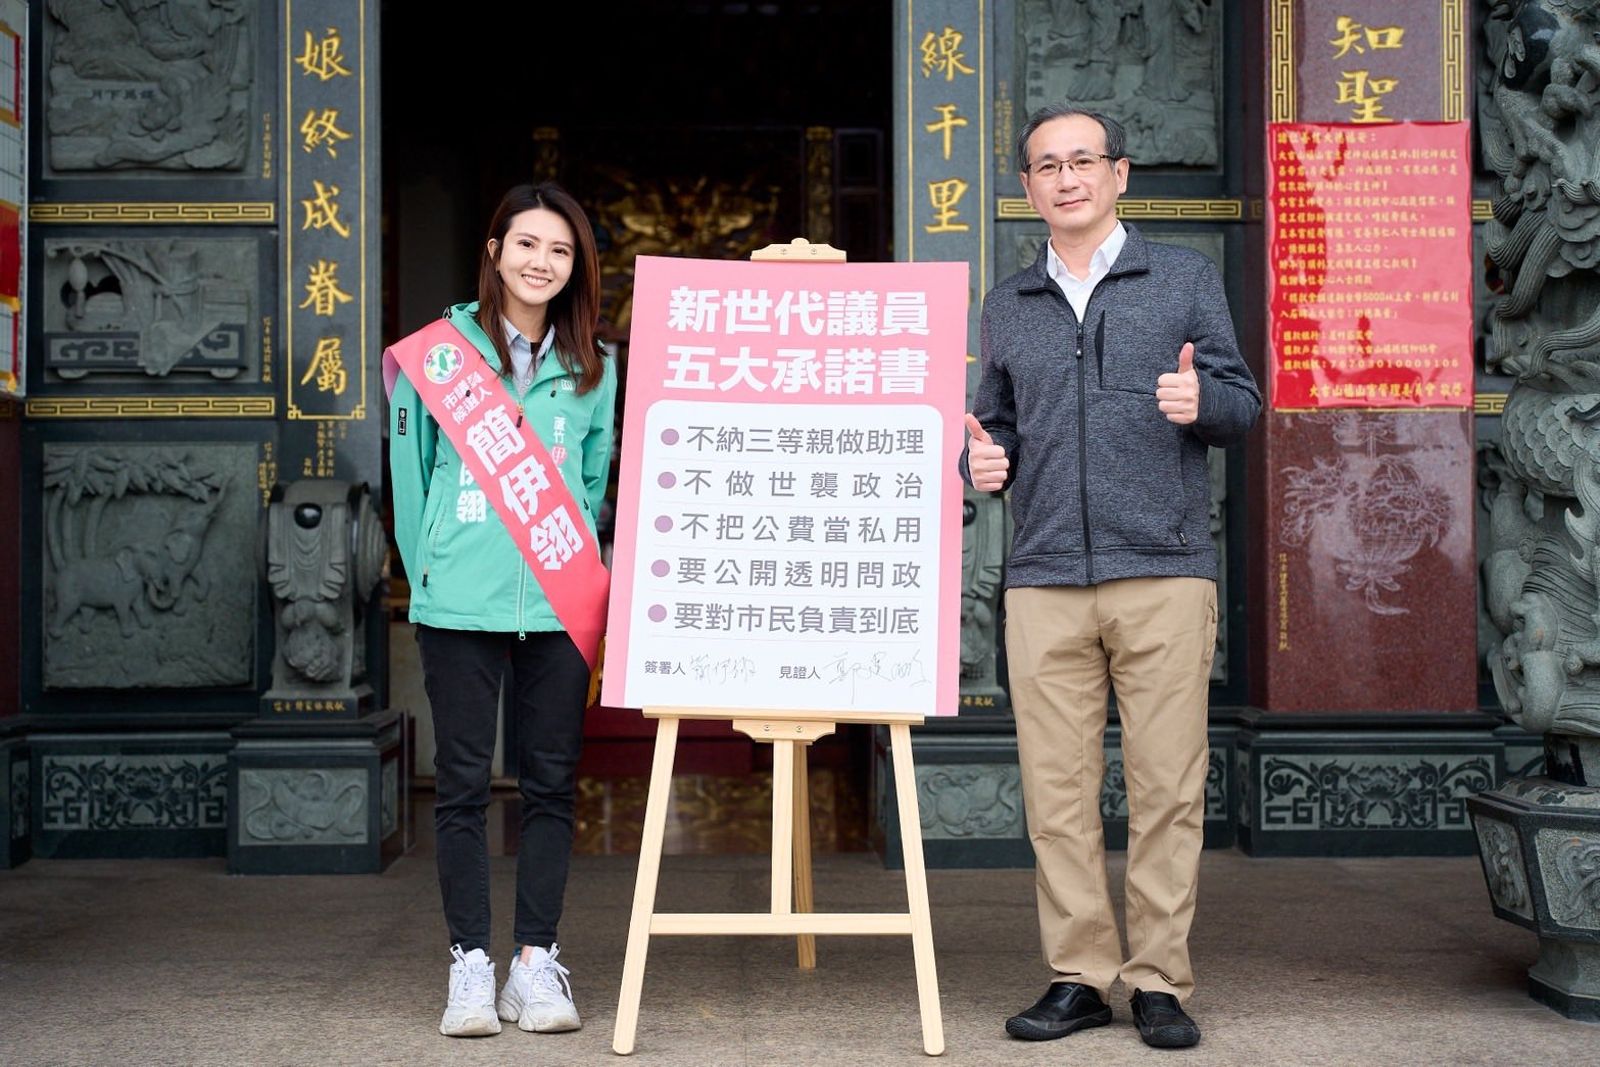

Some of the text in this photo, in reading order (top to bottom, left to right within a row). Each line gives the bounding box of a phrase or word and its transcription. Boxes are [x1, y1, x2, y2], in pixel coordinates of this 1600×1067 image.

[1329, 15, 1404, 123] 知聖
[295, 28, 353, 396] 娘終成眷屬
[667, 286, 929, 337] 新世代議員
[662, 344, 929, 395] 五大承諾書
[686, 425, 924, 456] 不納三等親做助理
[466, 404, 584, 571] 簡伊翎
[684, 469, 923, 500] 不做世襲政治
[681, 512, 921, 544] 不把公費當私用
[677, 557, 920, 589] 要公開透明問政
[674, 602, 919, 634] 要對市民負責到底
[644, 659, 686, 676] 簽署人
[779, 665, 821, 681] 見證人
